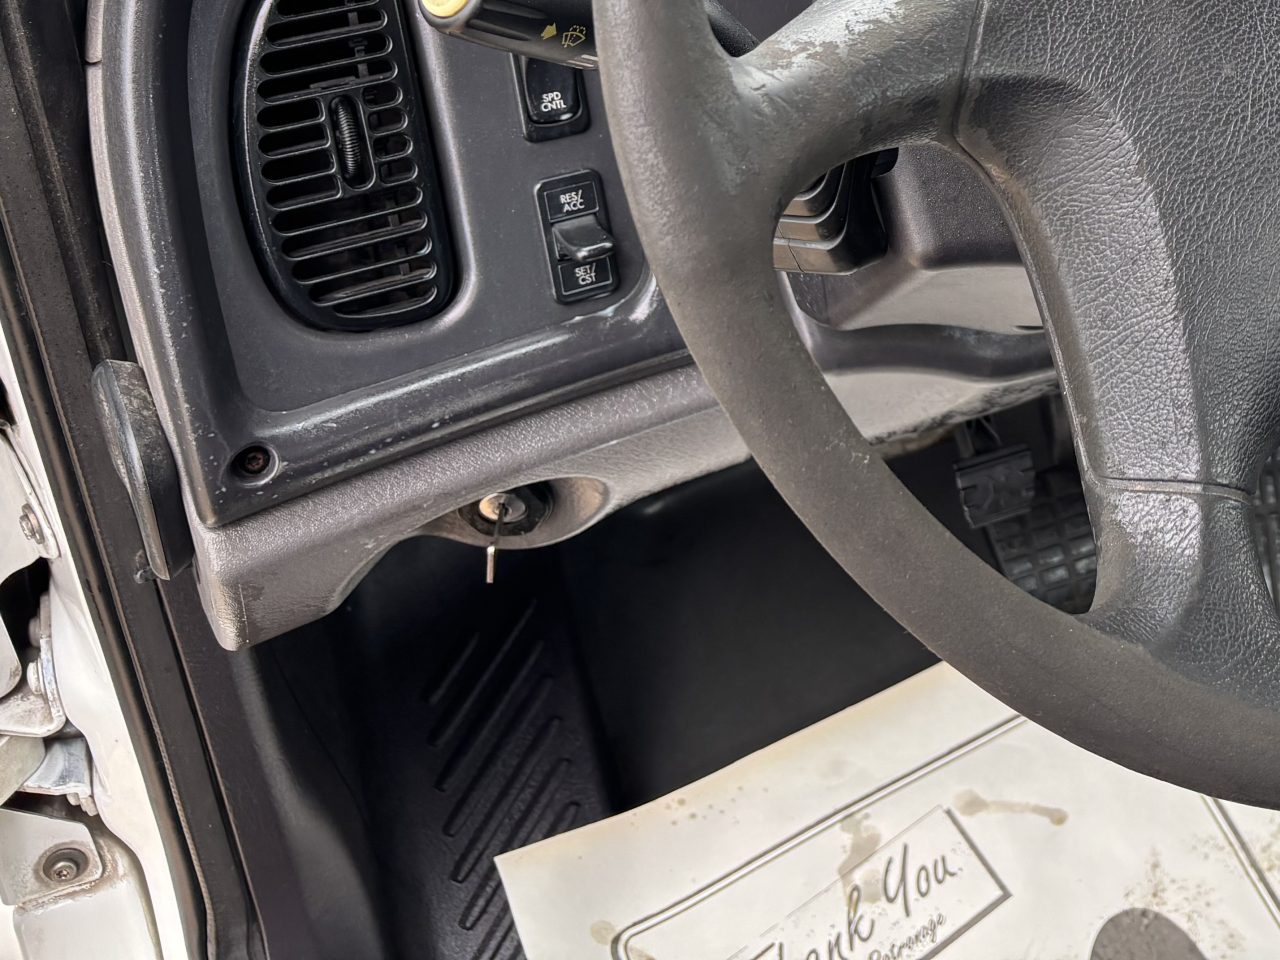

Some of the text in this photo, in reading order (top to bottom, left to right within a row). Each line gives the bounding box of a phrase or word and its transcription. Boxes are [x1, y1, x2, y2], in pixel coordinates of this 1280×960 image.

[543, 92, 562, 102] SPD
[541, 100, 567, 112] CNTL
[560, 190, 583, 204] RES/
[563, 200, 585, 212] ACC
[575, 263, 596, 277] SET/
[578, 273, 597, 285] CST
